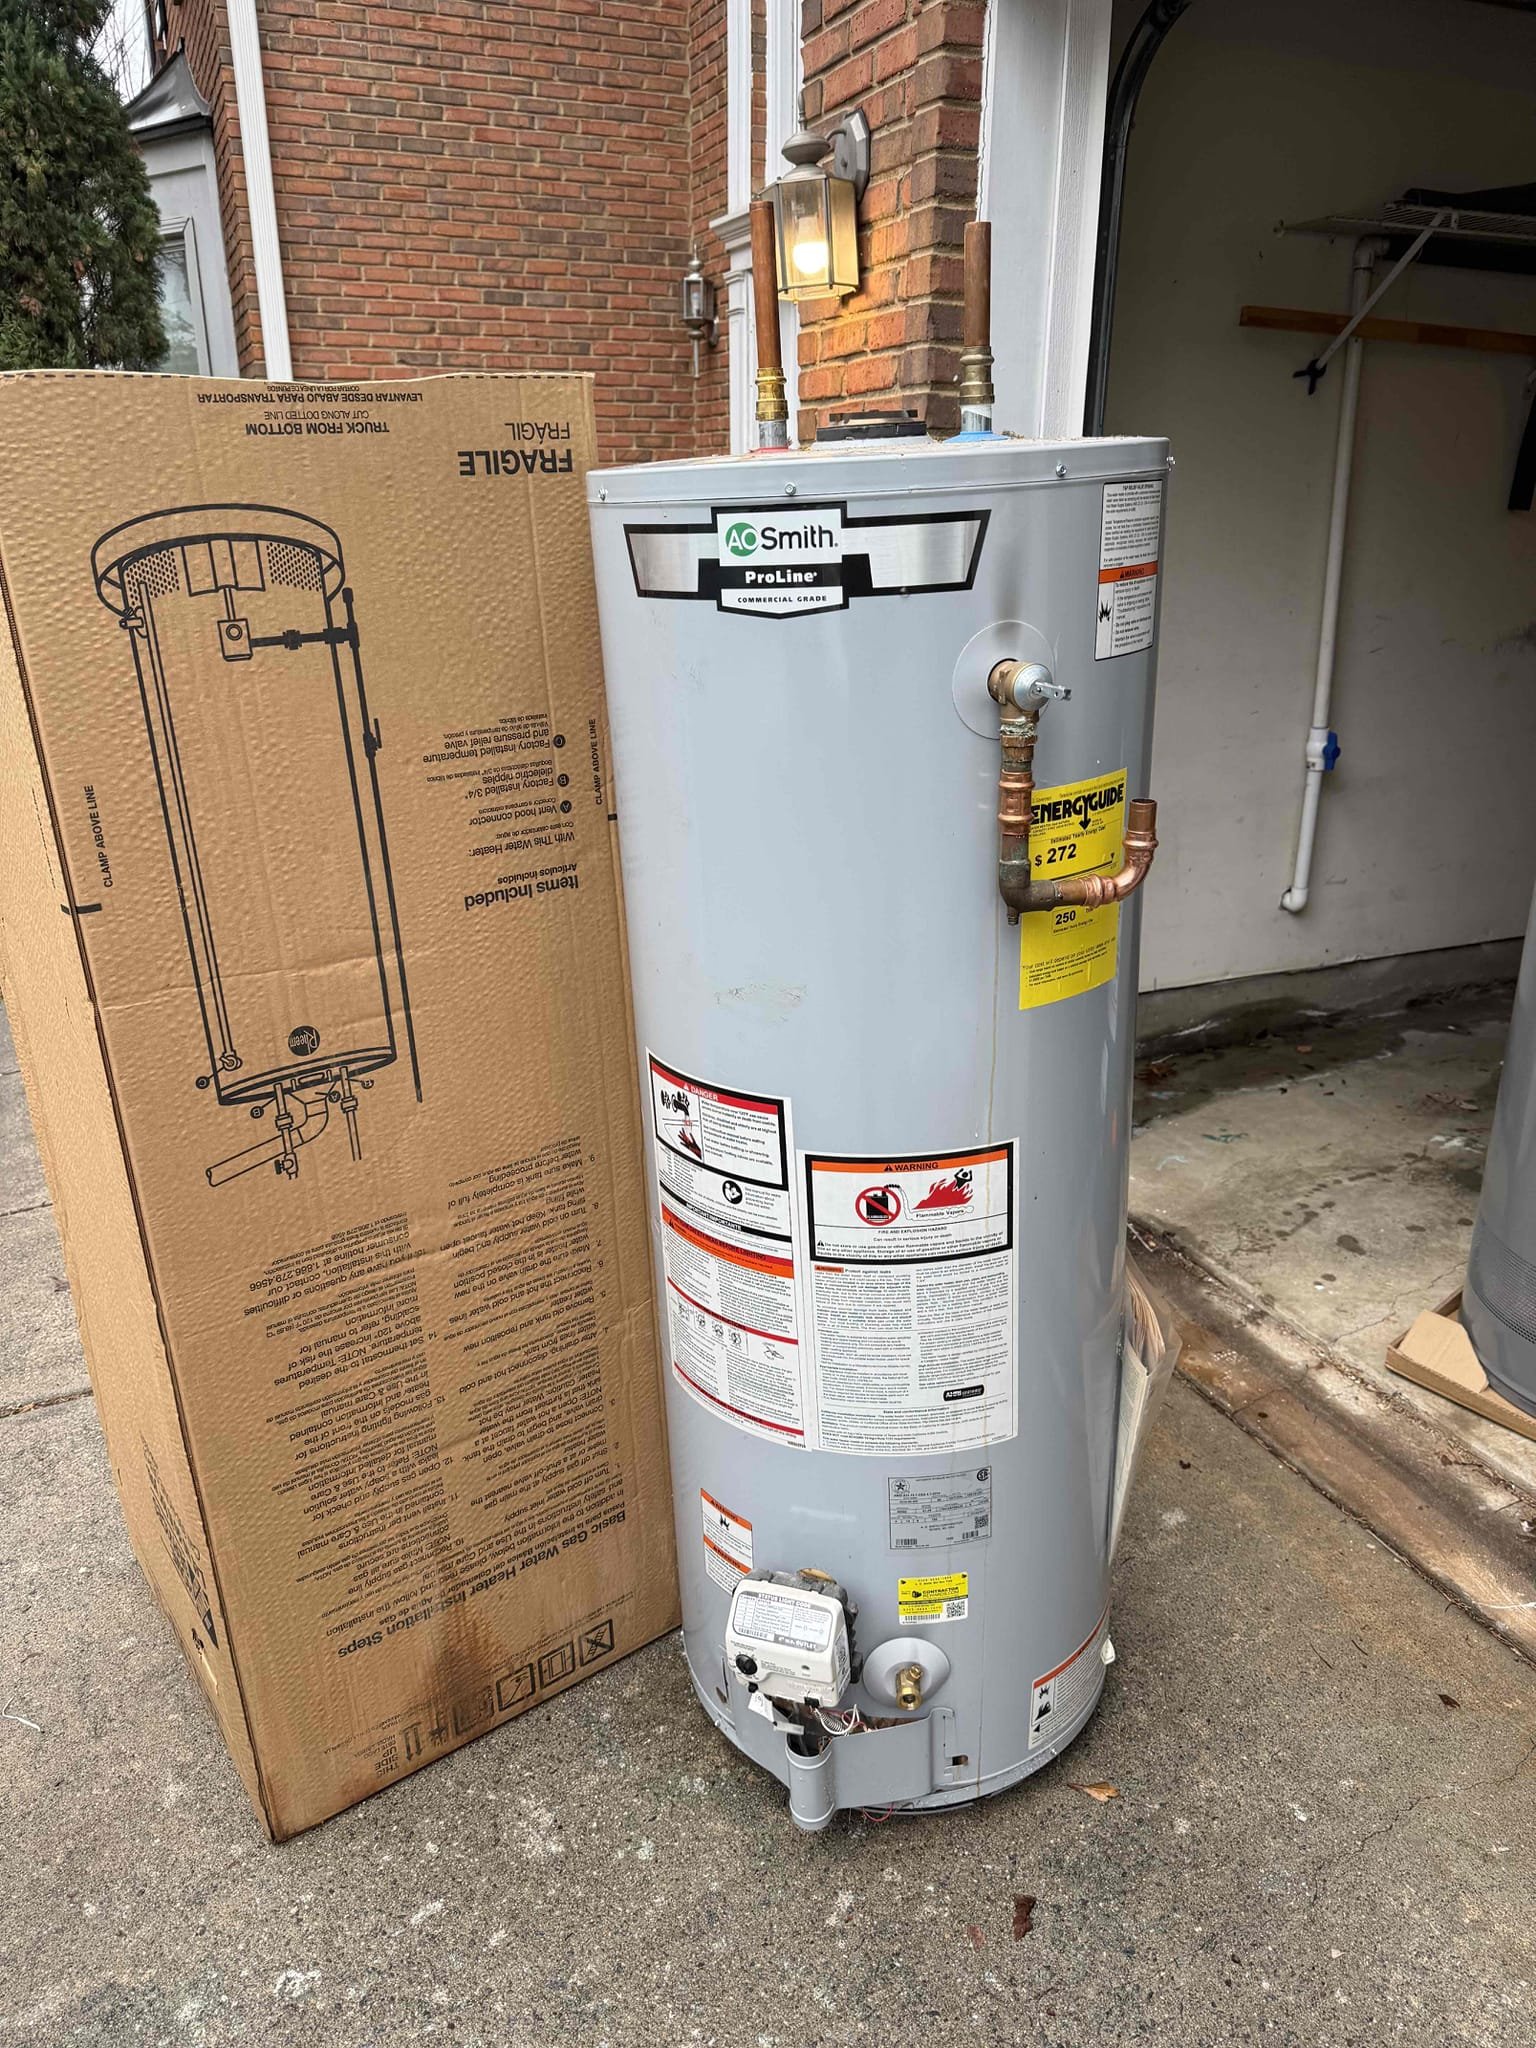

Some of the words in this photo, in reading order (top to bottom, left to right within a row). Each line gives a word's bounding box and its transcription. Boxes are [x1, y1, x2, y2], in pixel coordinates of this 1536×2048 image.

[197, 393, 273, 403] TRANSPORTAR
[277, 393, 303, 402] PARA
[307, 393, 339, 402] ABAJO
[341, 393, 373, 402] DESDE
[375, 392, 422, 402] LEVANTAR
[264, 411, 282, 420] LINE
[283, 411, 319, 420] DOTTED
[321, 410, 350, 419] ALONG
[351, 410, 368, 419] CUT
[245, 423, 301, 435] BOTTOM
[306, 423, 342, 434] FROM
[345, 422, 389, 433] TRUCK
[504, 423, 570, 444] FRÁGIL
[458, 449, 573, 475] FRAGILE
[761, 525, 833, 550] Smith
[745, 569, 814, 583] ProLine
[533, 729, 549, 739] and
[589, 719, 598, 739] LINE
[470, 736, 491, 749] relief
[493, 731, 530, 744] pressure
[444, 738, 468, 751] valve
[480, 744, 515, 756] installed
[518, 739, 550, 751] Factory
[422, 748, 477, 765] temperature
[591, 741, 601, 773] ABOVE
[482, 771, 513, 785] nipples
[515, 767, 553, 780] dielectric
[522, 777, 554, 789] Factory
[559, 776, 567, 785] B
[484, 782, 520, 795] installed
[593, 775, 603, 806] CLAMP
[84, 784, 98, 810] LINE
[514, 807, 536, 820] hood
[538, 805, 557, 816] Vent
[562, 803, 570, 811] A
[468, 811, 512, 826] connector
[90, 811, 106, 849] ABOVE
[533, 834, 553, 847] This
[554, 831, 575, 844] With
[468, 844, 502, 858] Heater:
[505, 838, 532, 852] Water
[1035, 854, 1042, 867] $
[1047, 844, 1076, 864] 272
[98, 851, 113, 888] CLAMP
[536, 875, 579, 894] Items
[464, 884, 533, 911] Included
[1055, 910, 1076, 925] 250
[290, 1030, 317, 1055] Rheem
[690, 1086, 718, 1101] DANGER
[895, 1162, 939, 1171] WARNING
[916, 1211, 944, 1219] Flammable
[374, 1248, 391, 1259] this
[392, 1242, 411, 1253] with
[322, 1255, 372, 1275] installation,
[285, 1272, 320, 1290] contact
[267, 1285, 283, 1296] our
[409, 1335, 424, 1346] Set
[361, 1342, 407, 1364] thermostat
[334, 1365, 348, 1374] the
[350, 1359, 359, 1368] to
[298, 1371, 331, 1389] desired
[591, 1510, 625, 1533] Basic
[561, 1530, 587, 1548] Gas
[519, 1545, 559, 1570] Water
[470, 1565, 515, 1596] Heater
[386, 1590, 466, 1634] Instllation
[337, 1631, 382, 1657] Steps
